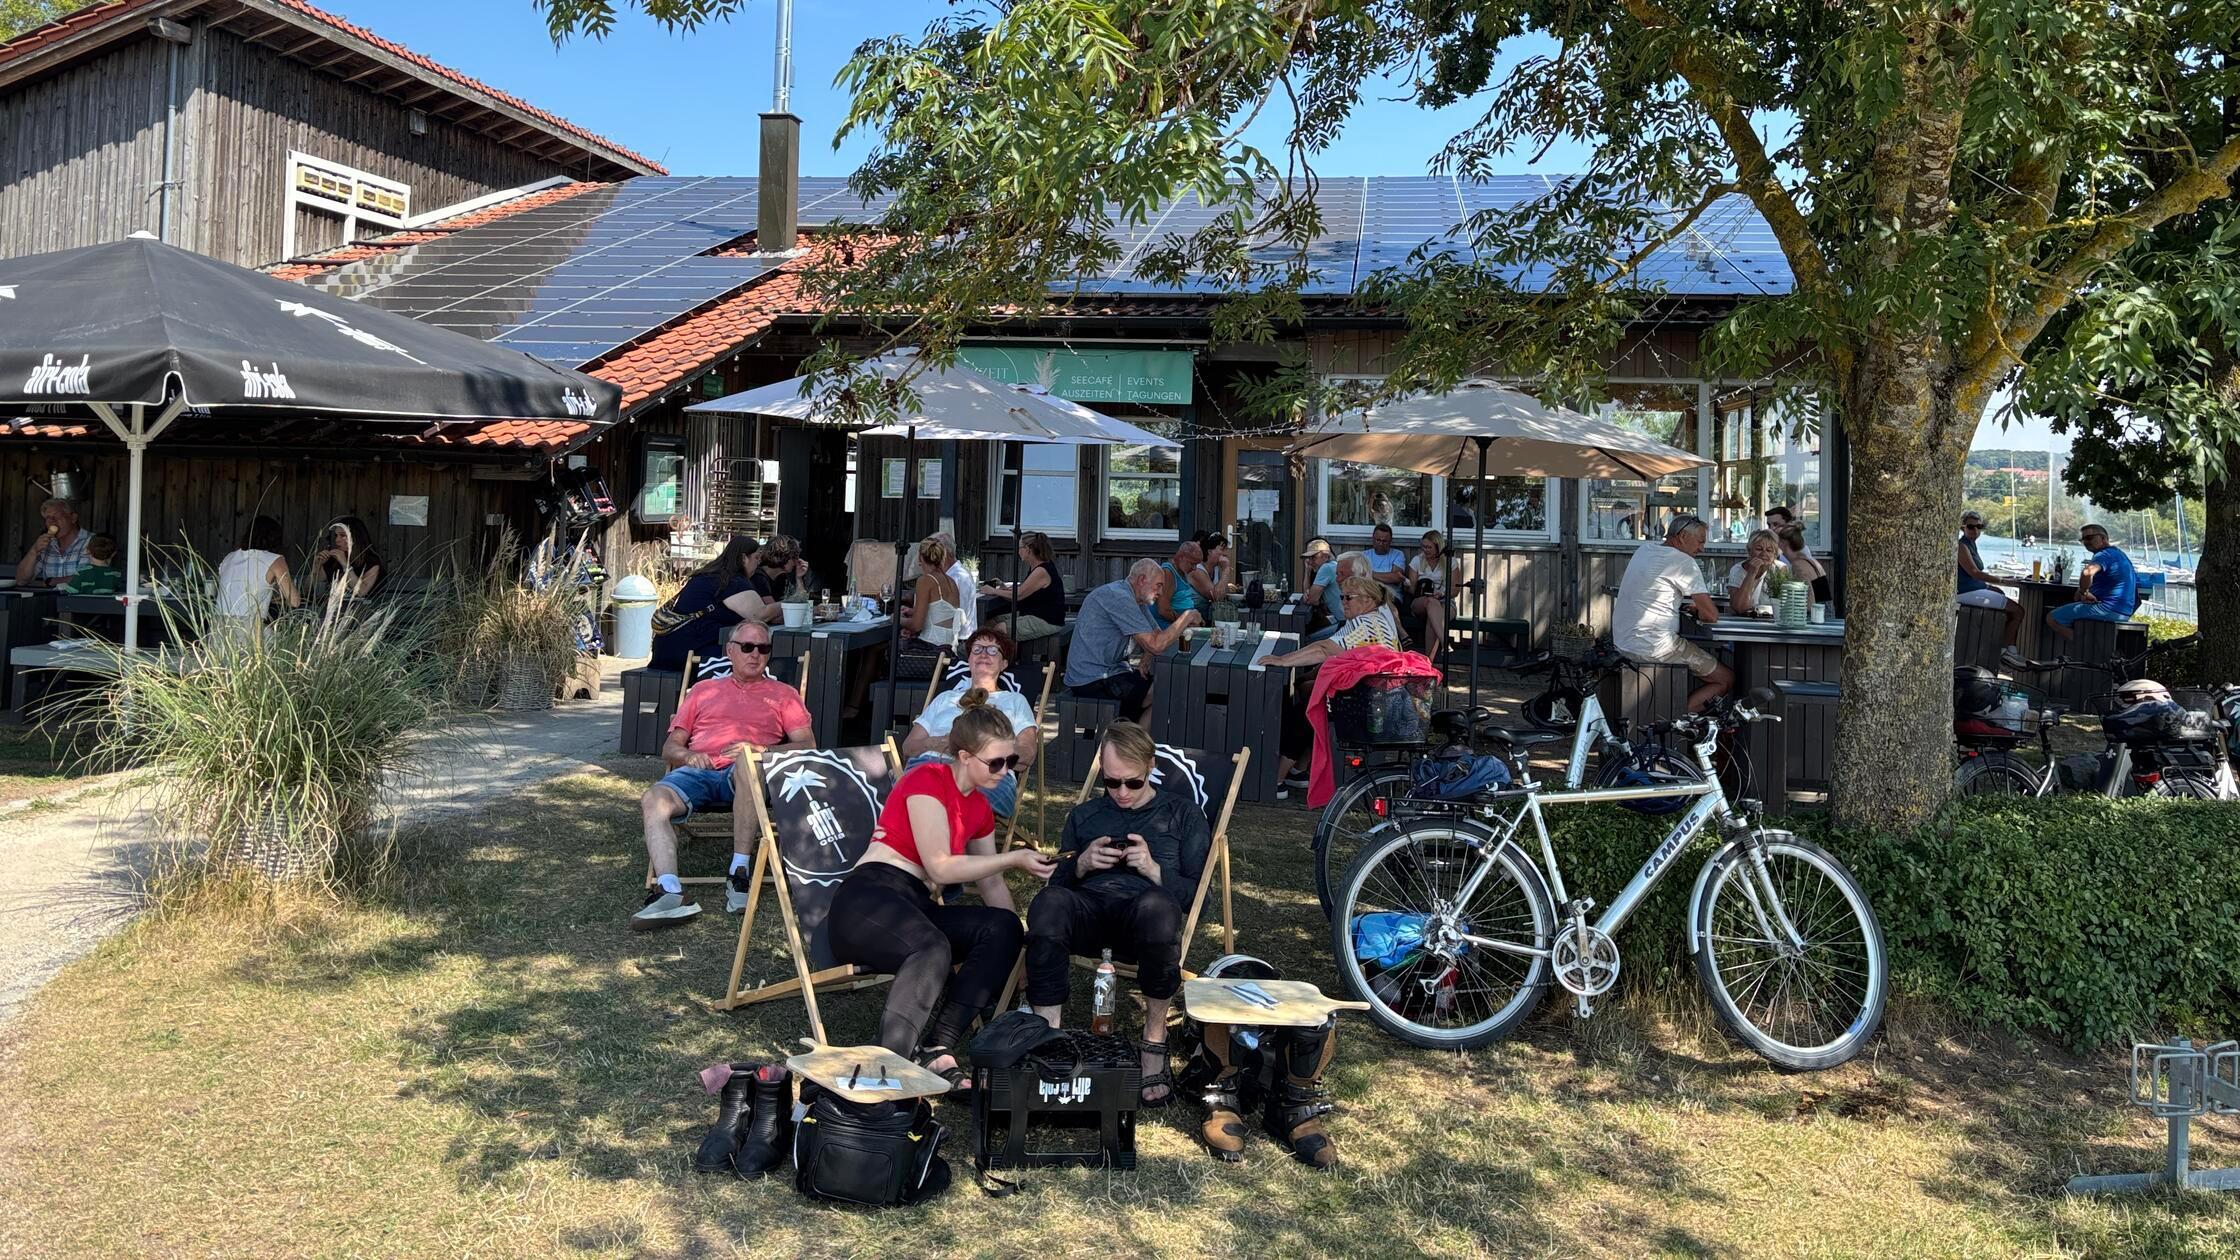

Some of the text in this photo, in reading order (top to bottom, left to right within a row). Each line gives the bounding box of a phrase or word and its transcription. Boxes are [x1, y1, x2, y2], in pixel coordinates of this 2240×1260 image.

[1127, 376, 1165, 386] EVENTS
[1061, 389, 1113, 399] AUSZEITEN
[1127, 390, 1182, 401] TAGUNGEN
[1644, 812, 1700, 879] CAMPUS
